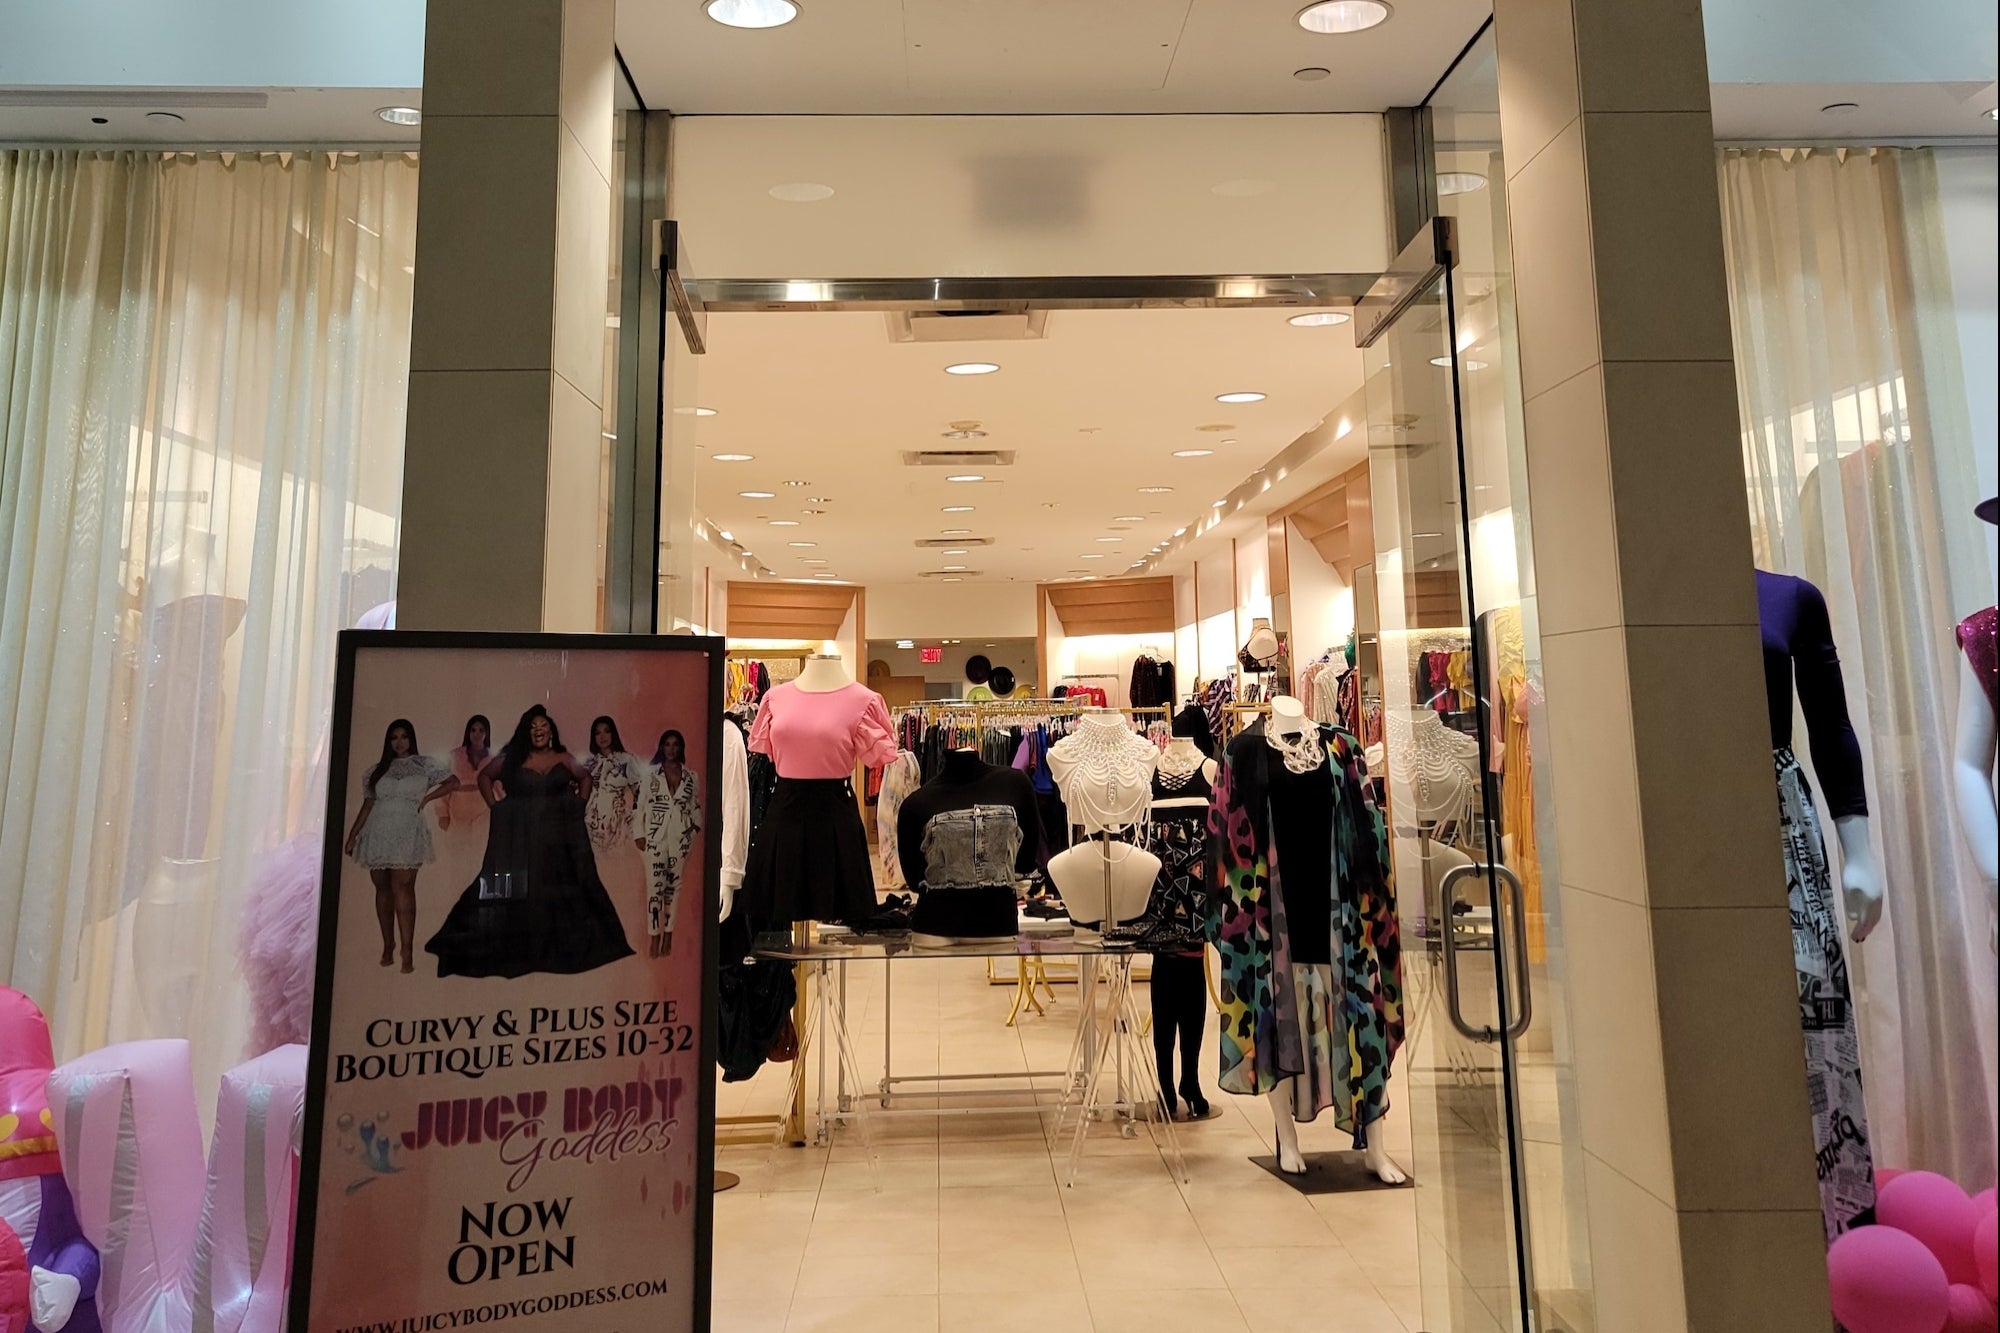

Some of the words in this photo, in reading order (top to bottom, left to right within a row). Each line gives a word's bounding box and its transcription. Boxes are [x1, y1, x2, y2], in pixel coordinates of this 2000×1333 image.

[921, 648, 941, 662] EXIT
[365, 1014, 485, 1048] CURVY
[492, 1009, 520, 1036] &
[528, 1005, 605, 1035] PLUS
[613, 1000, 679, 1027] SIZE
[334, 1042, 514, 1083] BOUTIQUE
[522, 1034, 608, 1066] SIZES
[616, 1025, 694, 1056] 10-32
[400, 1090, 548, 1151] JUICY
[563, 1077, 683, 1134] BODY
[499, 1106, 680, 1193] Goddess
[457, 1196, 574, 1244] NOW
[447, 1236, 576, 1285] OPEN
